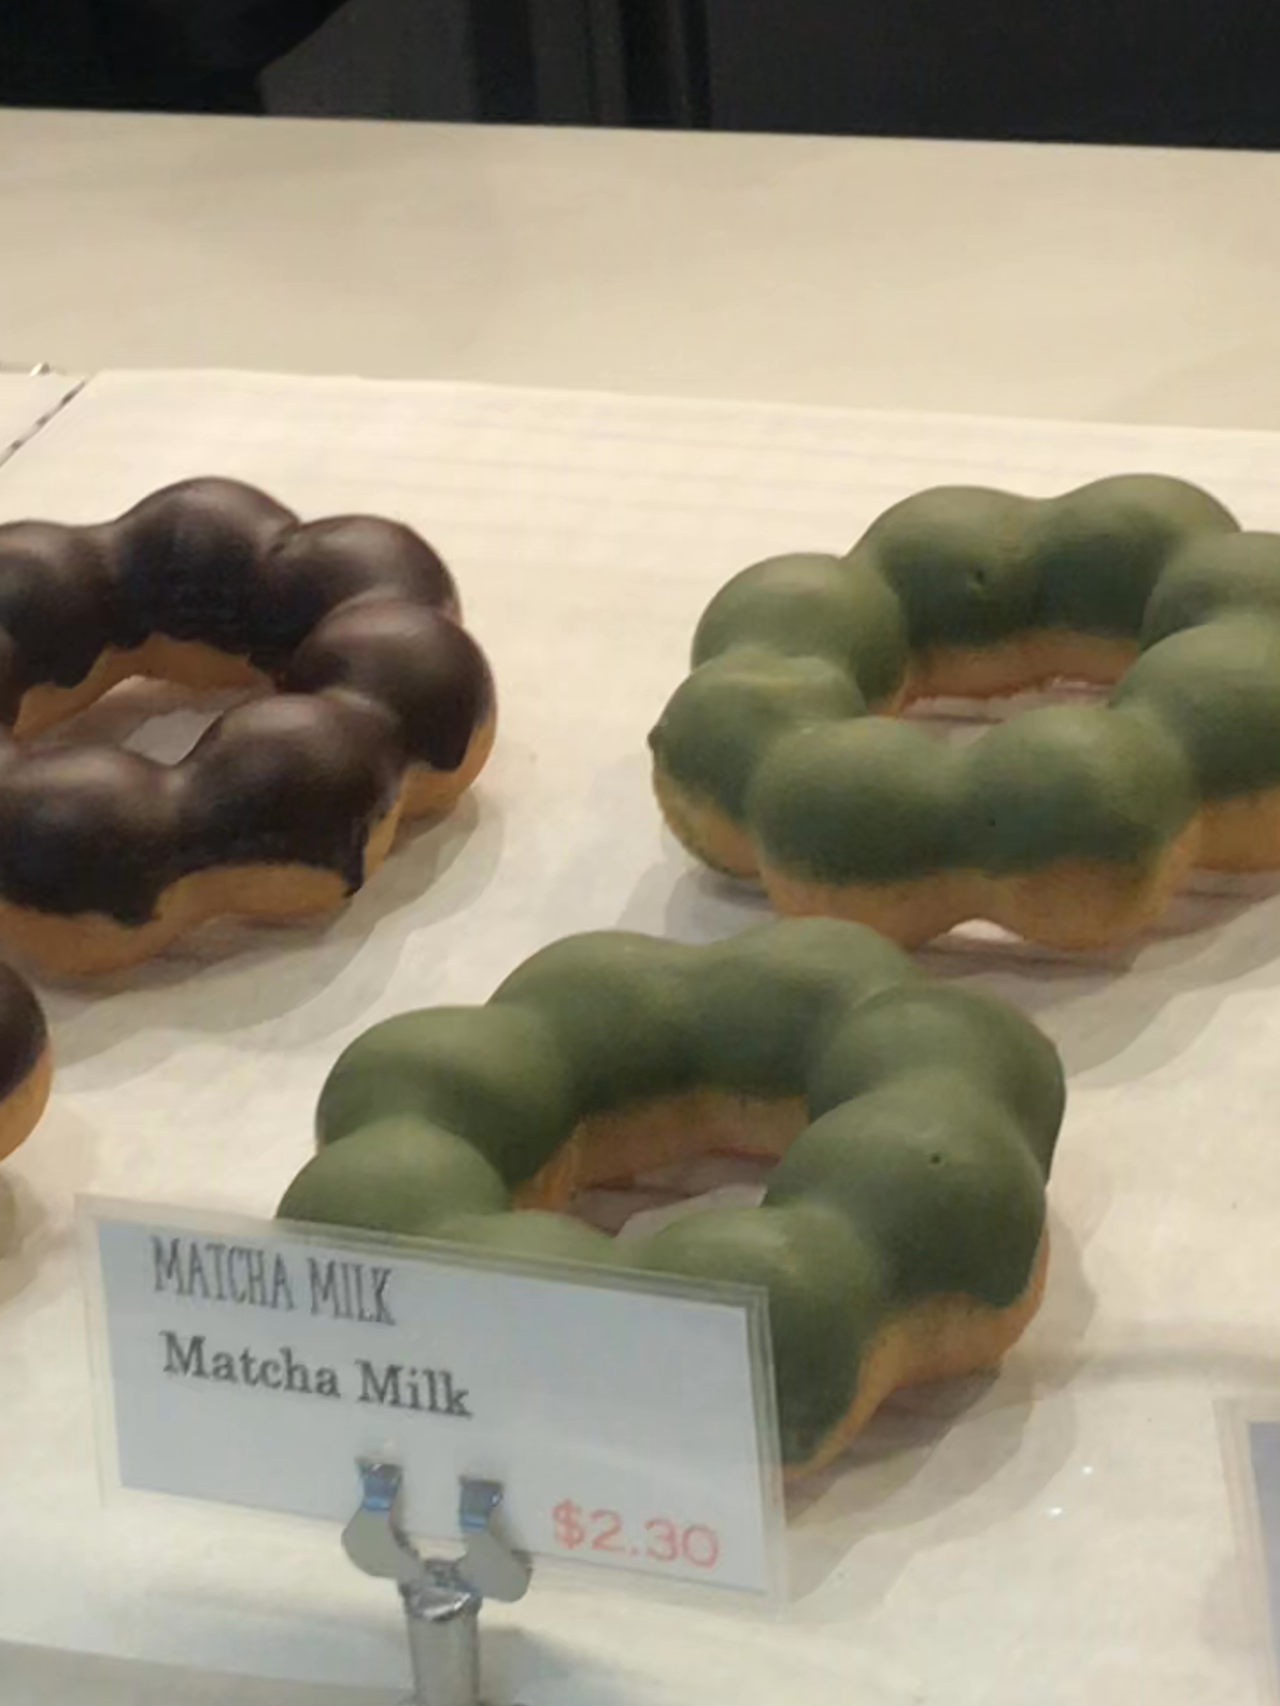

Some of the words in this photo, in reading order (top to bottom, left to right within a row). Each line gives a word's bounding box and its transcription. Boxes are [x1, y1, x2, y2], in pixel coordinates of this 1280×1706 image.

[150, 1236, 294, 1312] MATCHA
[308, 1258, 396, 1325] MILK
[160, 1330, 340, 1398] Matcha
[356, 1359, 472, 1418] Milk
[553, 1498, 720, 1569] $2.30
